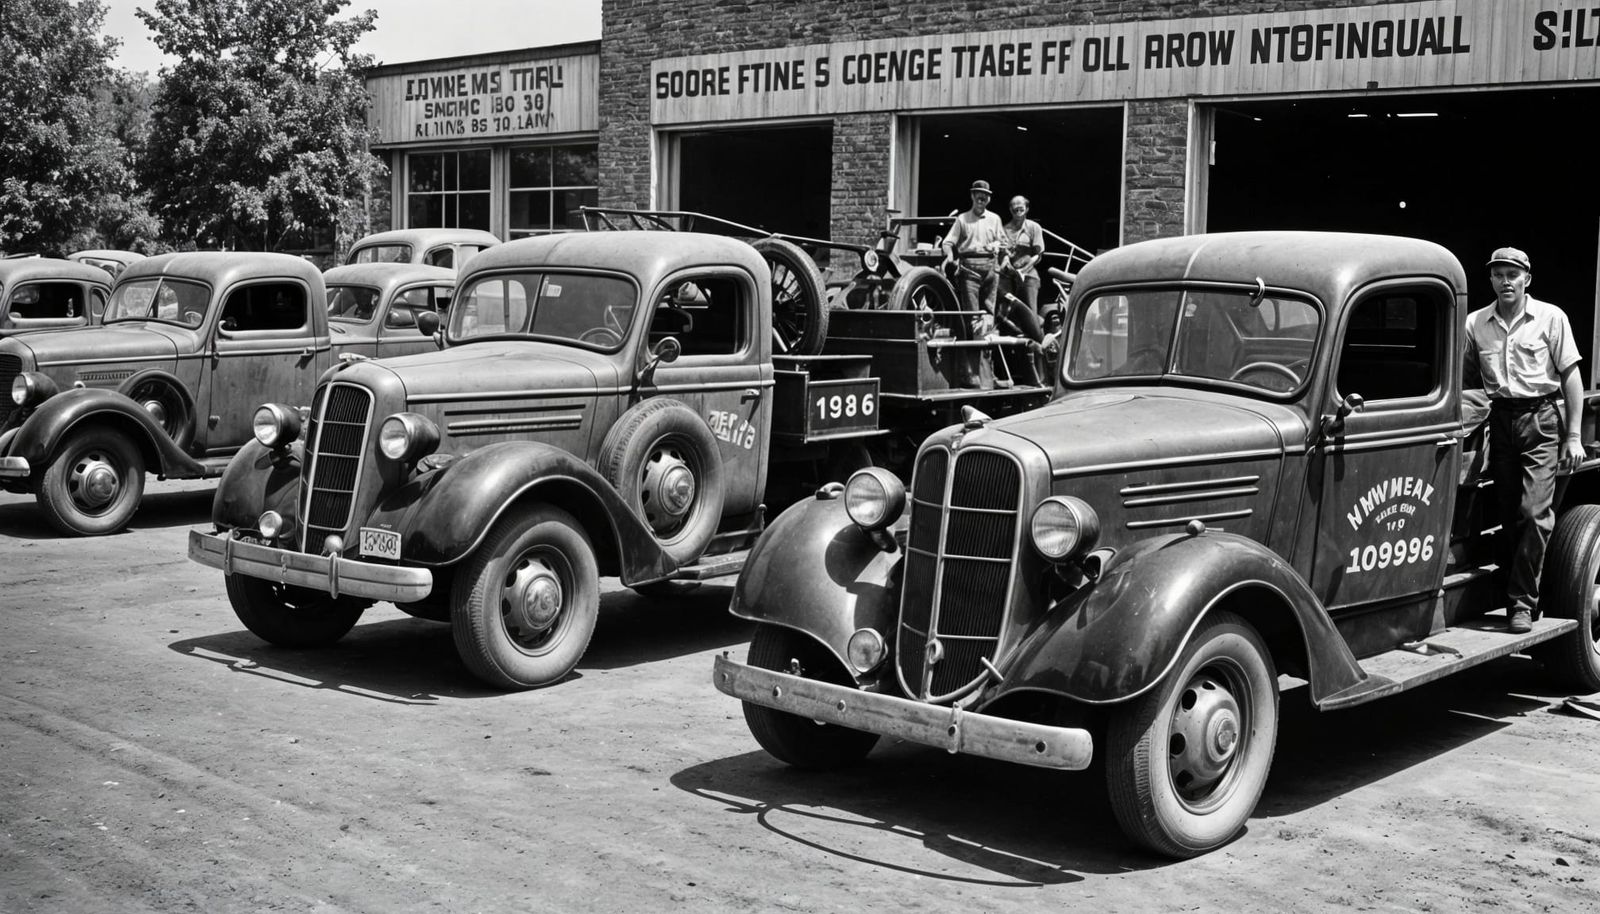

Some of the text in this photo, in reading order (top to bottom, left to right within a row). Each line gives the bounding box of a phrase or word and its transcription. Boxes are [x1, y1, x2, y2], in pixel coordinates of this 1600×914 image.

[656, 66, 730, 99] SOORE
[738, 60, 805, 94] FTINE
[951, 42, 1032, 78] TTAGE
[1041, 40, 1071, 75] FF
[1082, 36, 1130, 72] OLL
[816, 393, 874, 420] 1986
[1345, 534, 1435, 574] 109996
